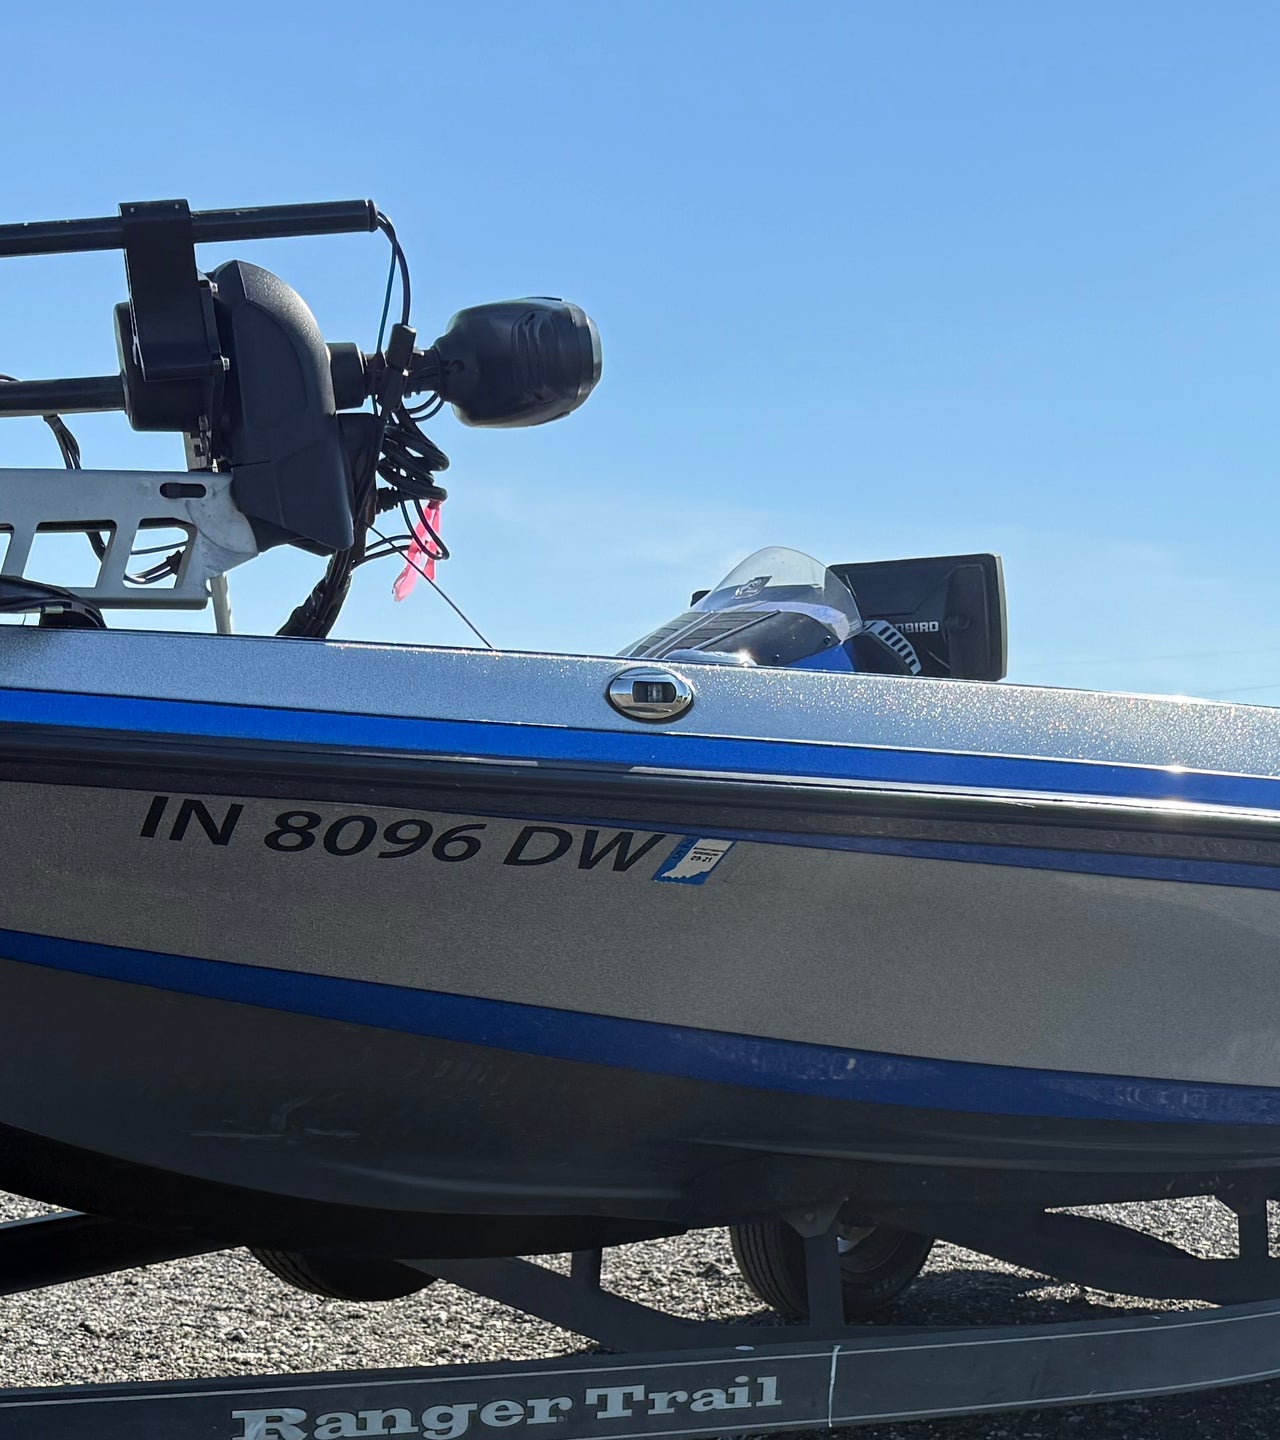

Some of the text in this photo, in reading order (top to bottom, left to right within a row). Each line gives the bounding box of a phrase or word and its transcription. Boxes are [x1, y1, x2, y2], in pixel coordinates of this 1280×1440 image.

[139, 795, 244, 846] IN
[263, 809, 487, 862] 8096
[501, 825, 667, 871] DW
[585, 1376, 783, 1420] Trail
